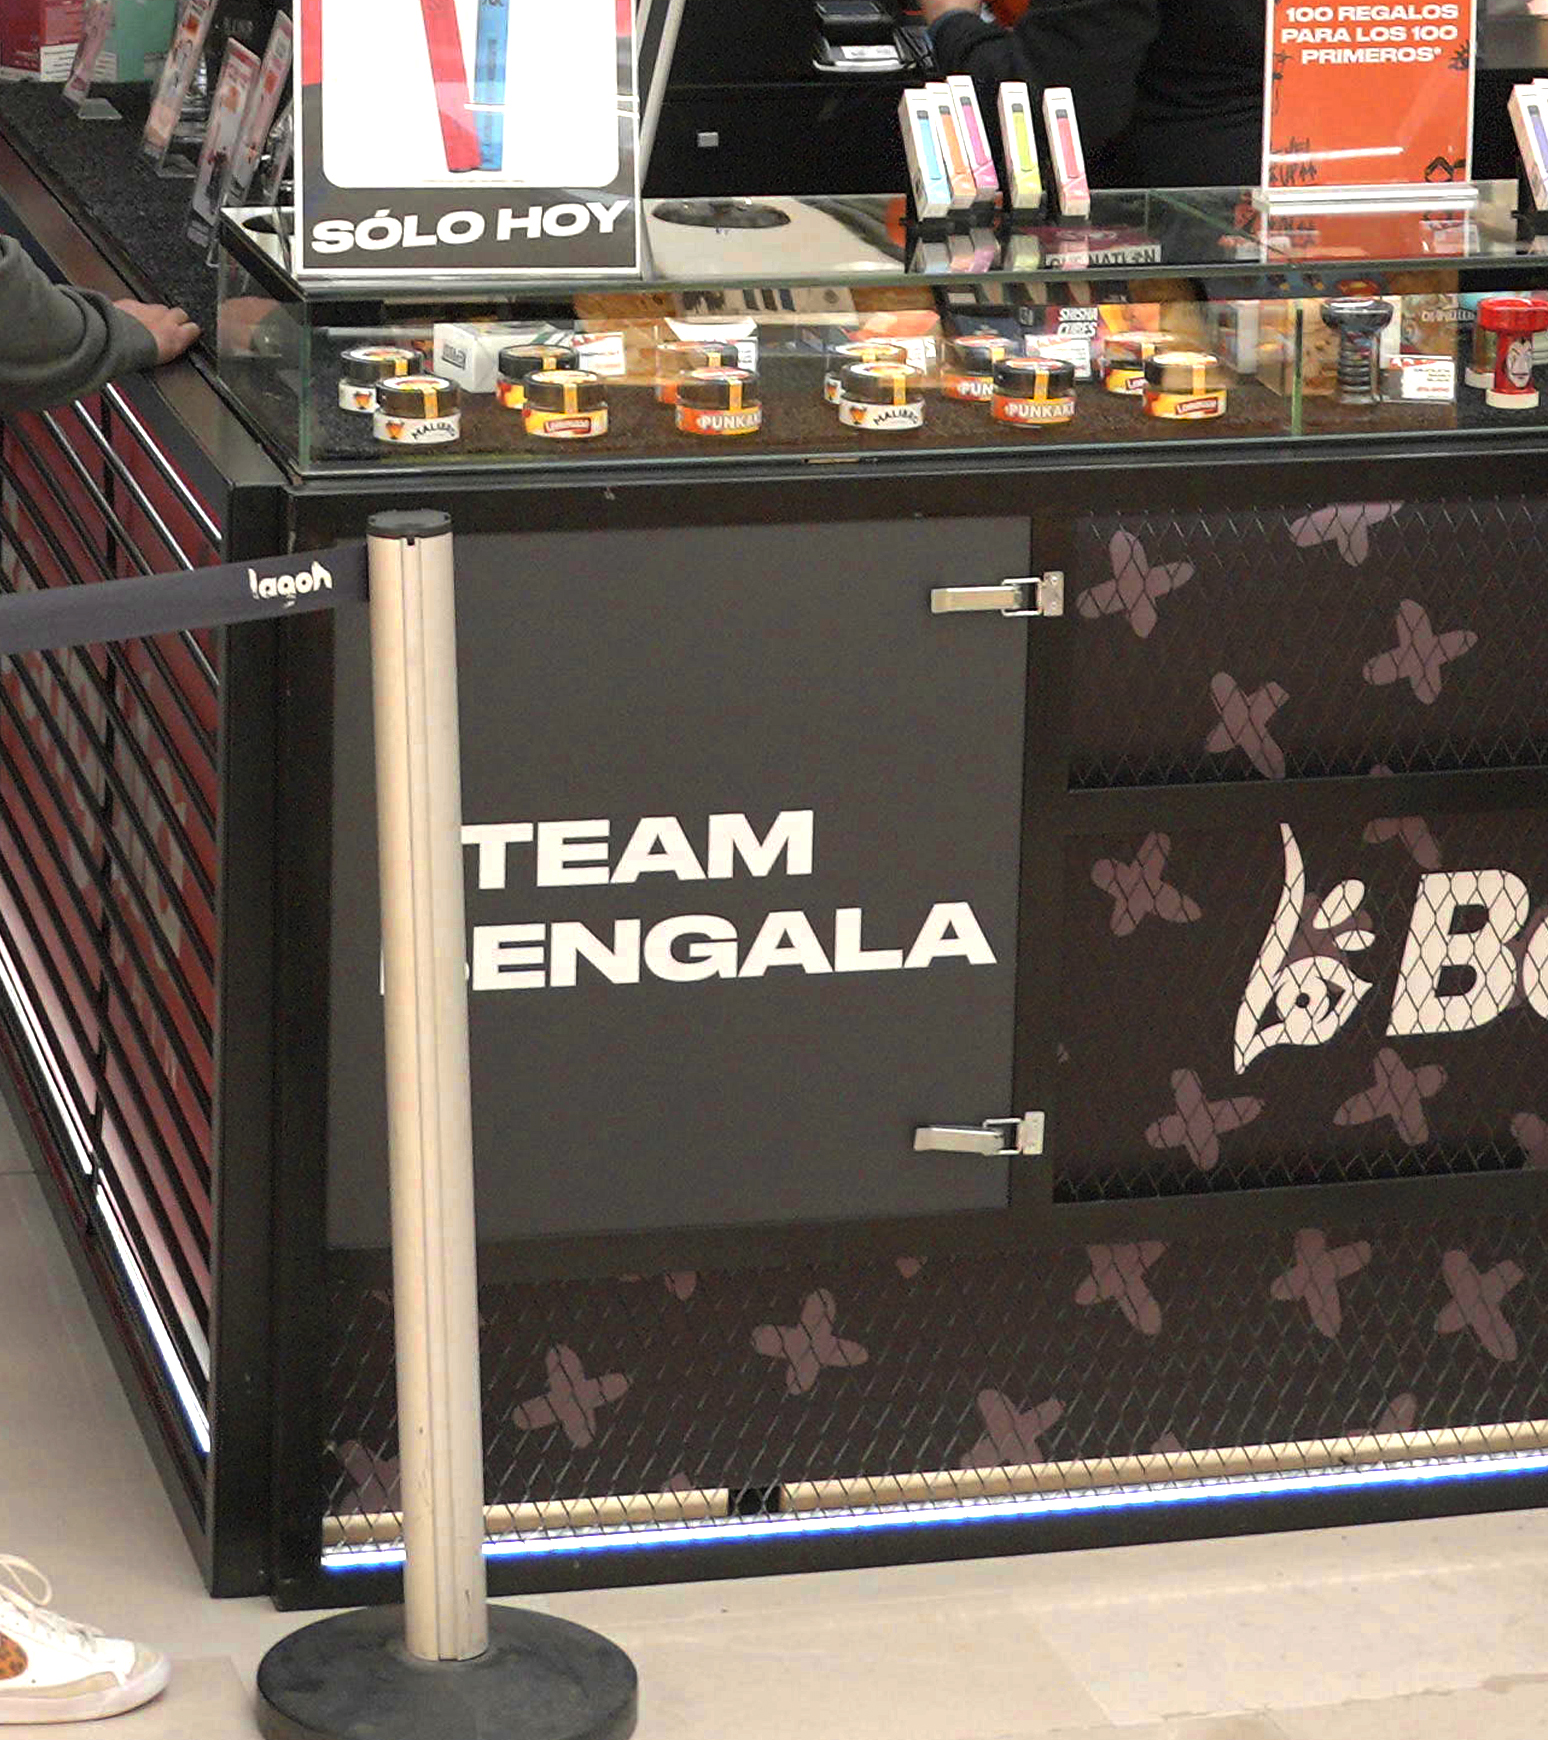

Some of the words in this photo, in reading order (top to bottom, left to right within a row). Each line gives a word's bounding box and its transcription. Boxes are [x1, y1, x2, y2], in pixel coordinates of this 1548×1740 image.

[1280, 28, 1352, 44] PARA
[1356, 26, 1407, 42] LOS
[1411, 25, 1459, 41] 100
[1285, 7, 1334, 23] 100
[1338, 4, 1460, 22] REGALOS
[311, 209, 486, 254] SÓLO
[496, 200, 631, 241] HOY
[247, 561, 333, 608] lagoh
[464, 809, 814, 890] TEAM
[380, 902, 997, 996] ENGALA
